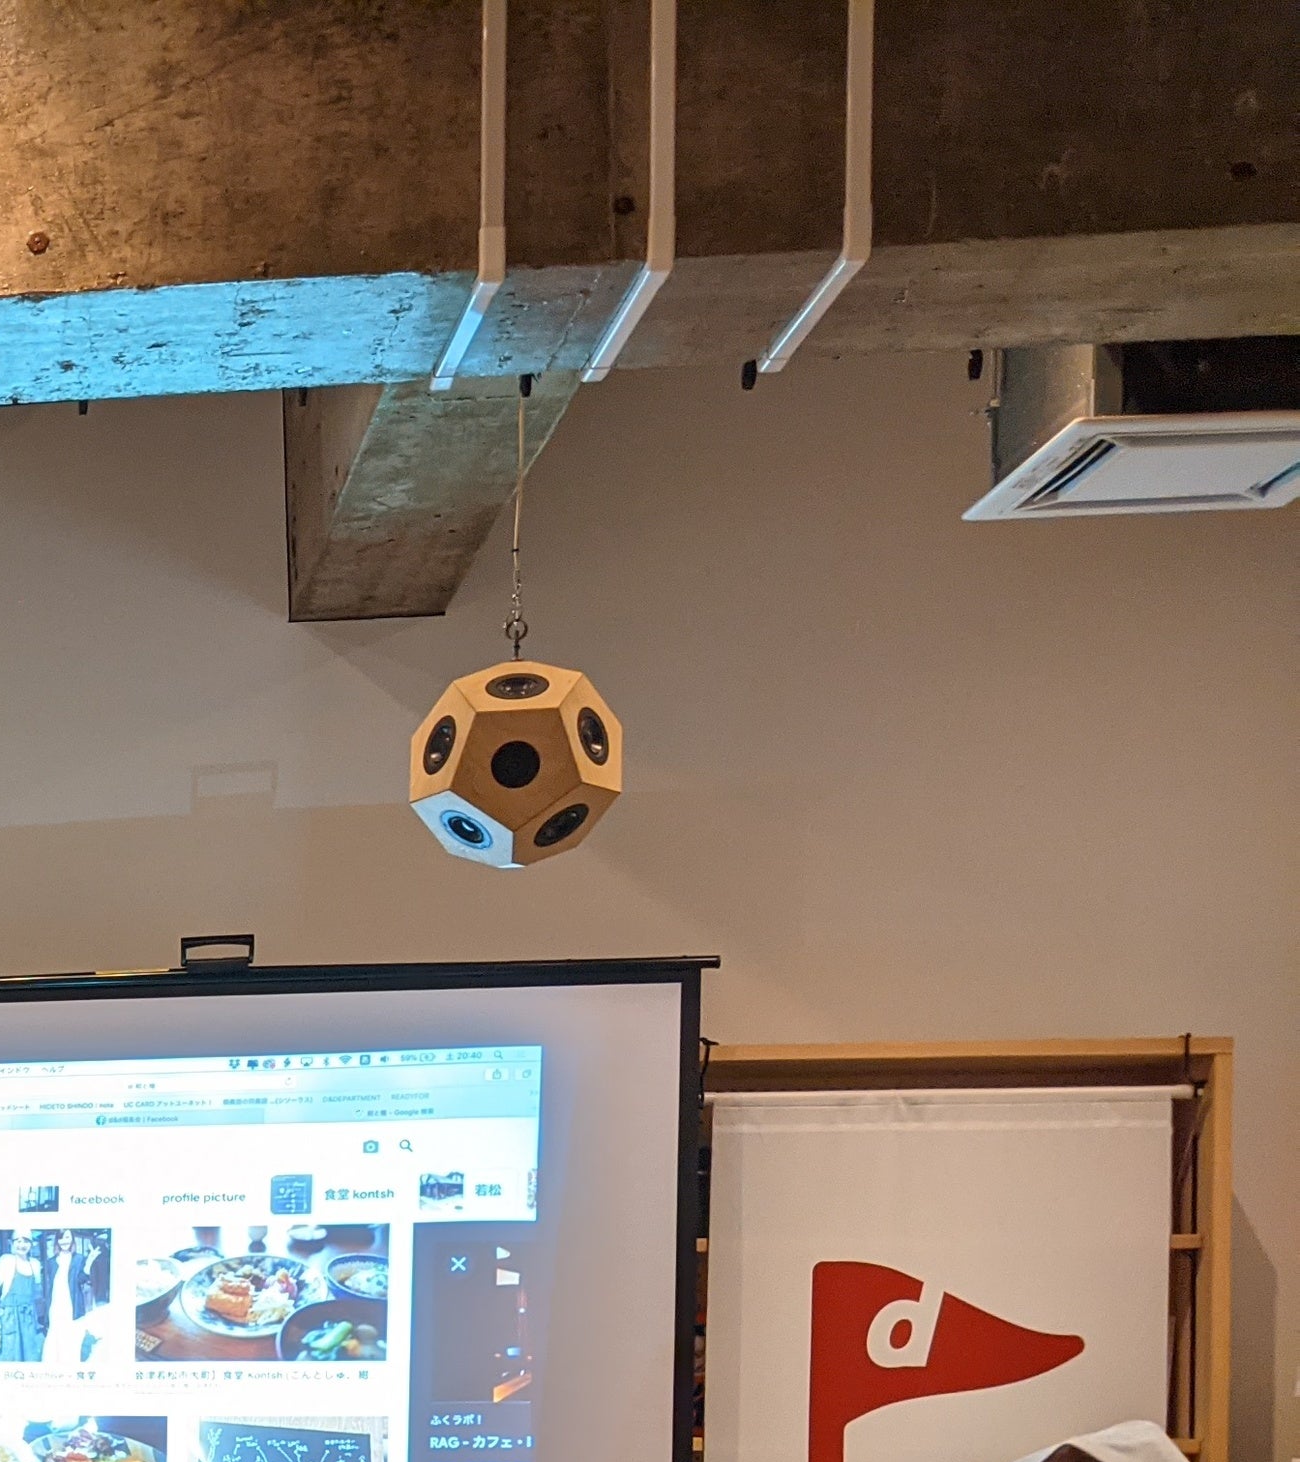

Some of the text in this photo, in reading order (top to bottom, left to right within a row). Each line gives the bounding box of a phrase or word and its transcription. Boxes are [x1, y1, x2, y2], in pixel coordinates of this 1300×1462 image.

[457, 1051, 483, 1061] 20:40
[41, 1065, 65, 1073] ヘルプ
[324, 1188, 395, 1201] 食堂 kontsh
[474, 1184, 502, 1196] 若松
[70, 1194, 125, 1205] facebook
[162, 1192, 246, 1205] profile picture
[866, 1280, 945, 1368] d
[429, 1435, 532, 1449] RAG カフェ・
